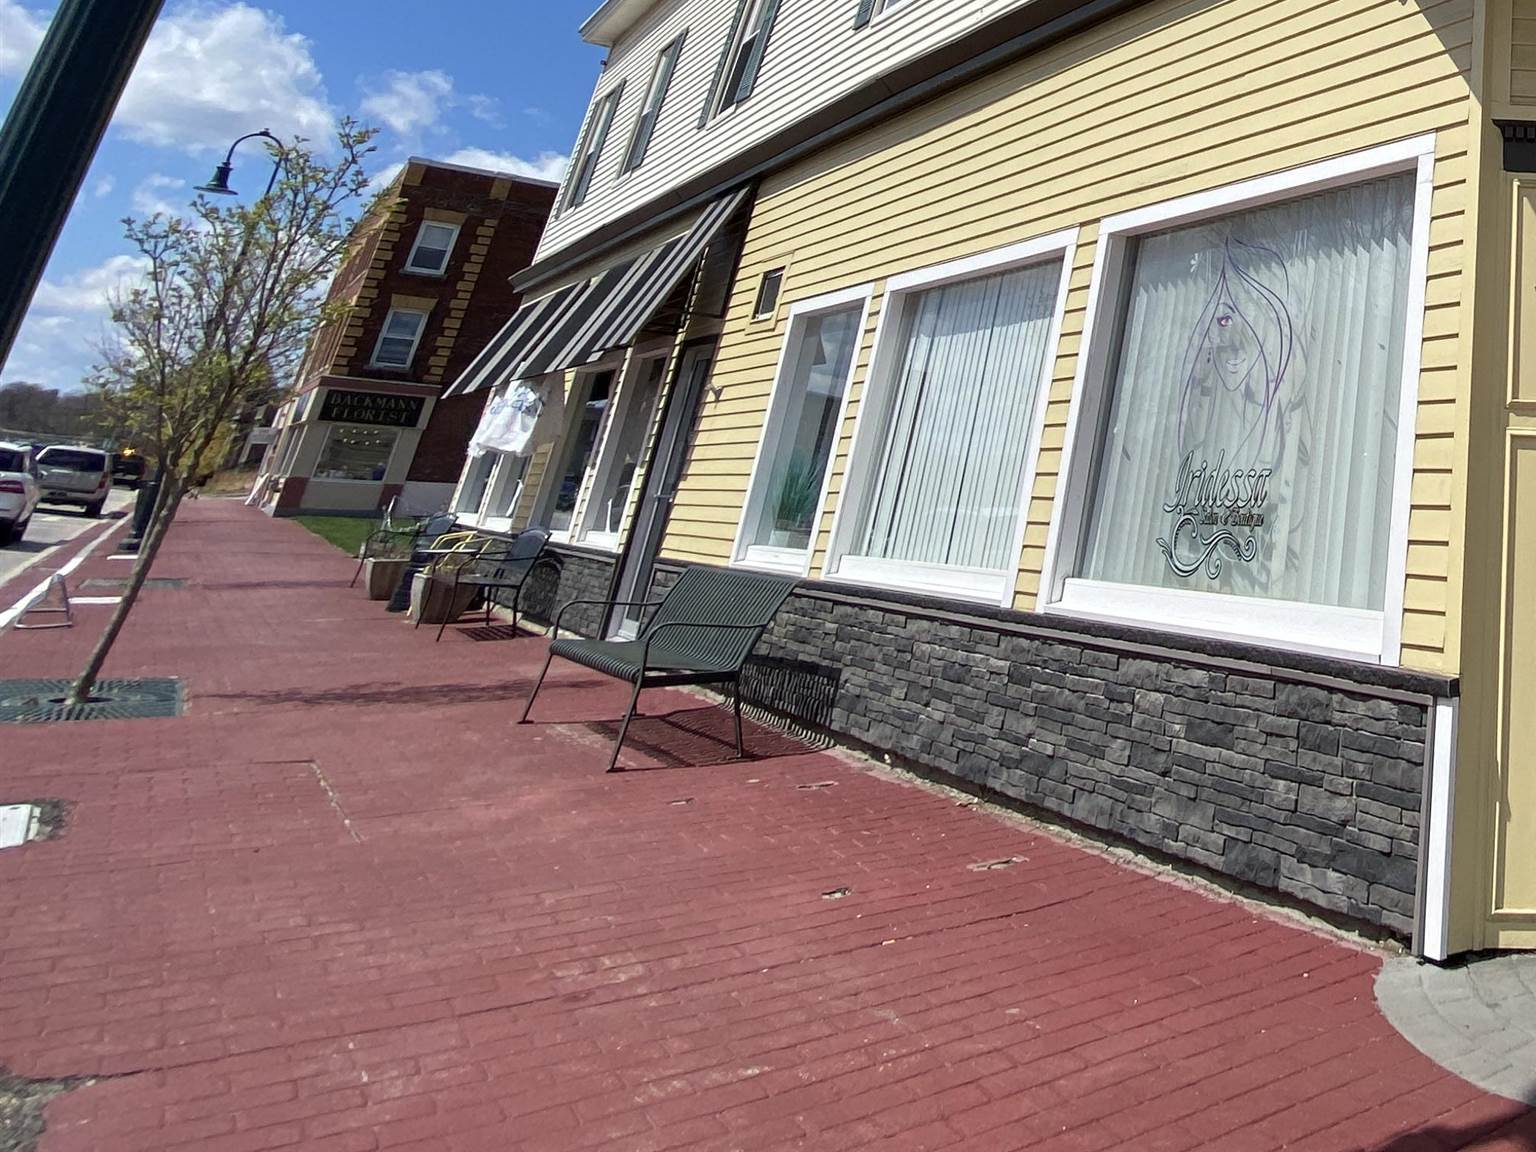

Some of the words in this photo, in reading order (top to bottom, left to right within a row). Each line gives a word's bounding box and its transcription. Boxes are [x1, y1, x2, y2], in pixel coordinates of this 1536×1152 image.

[330, 393, 419, 410] BACKMANN
[330, 408, 411, 423] FLORIST
[1163, 449, 1273, 513] Iridessa
